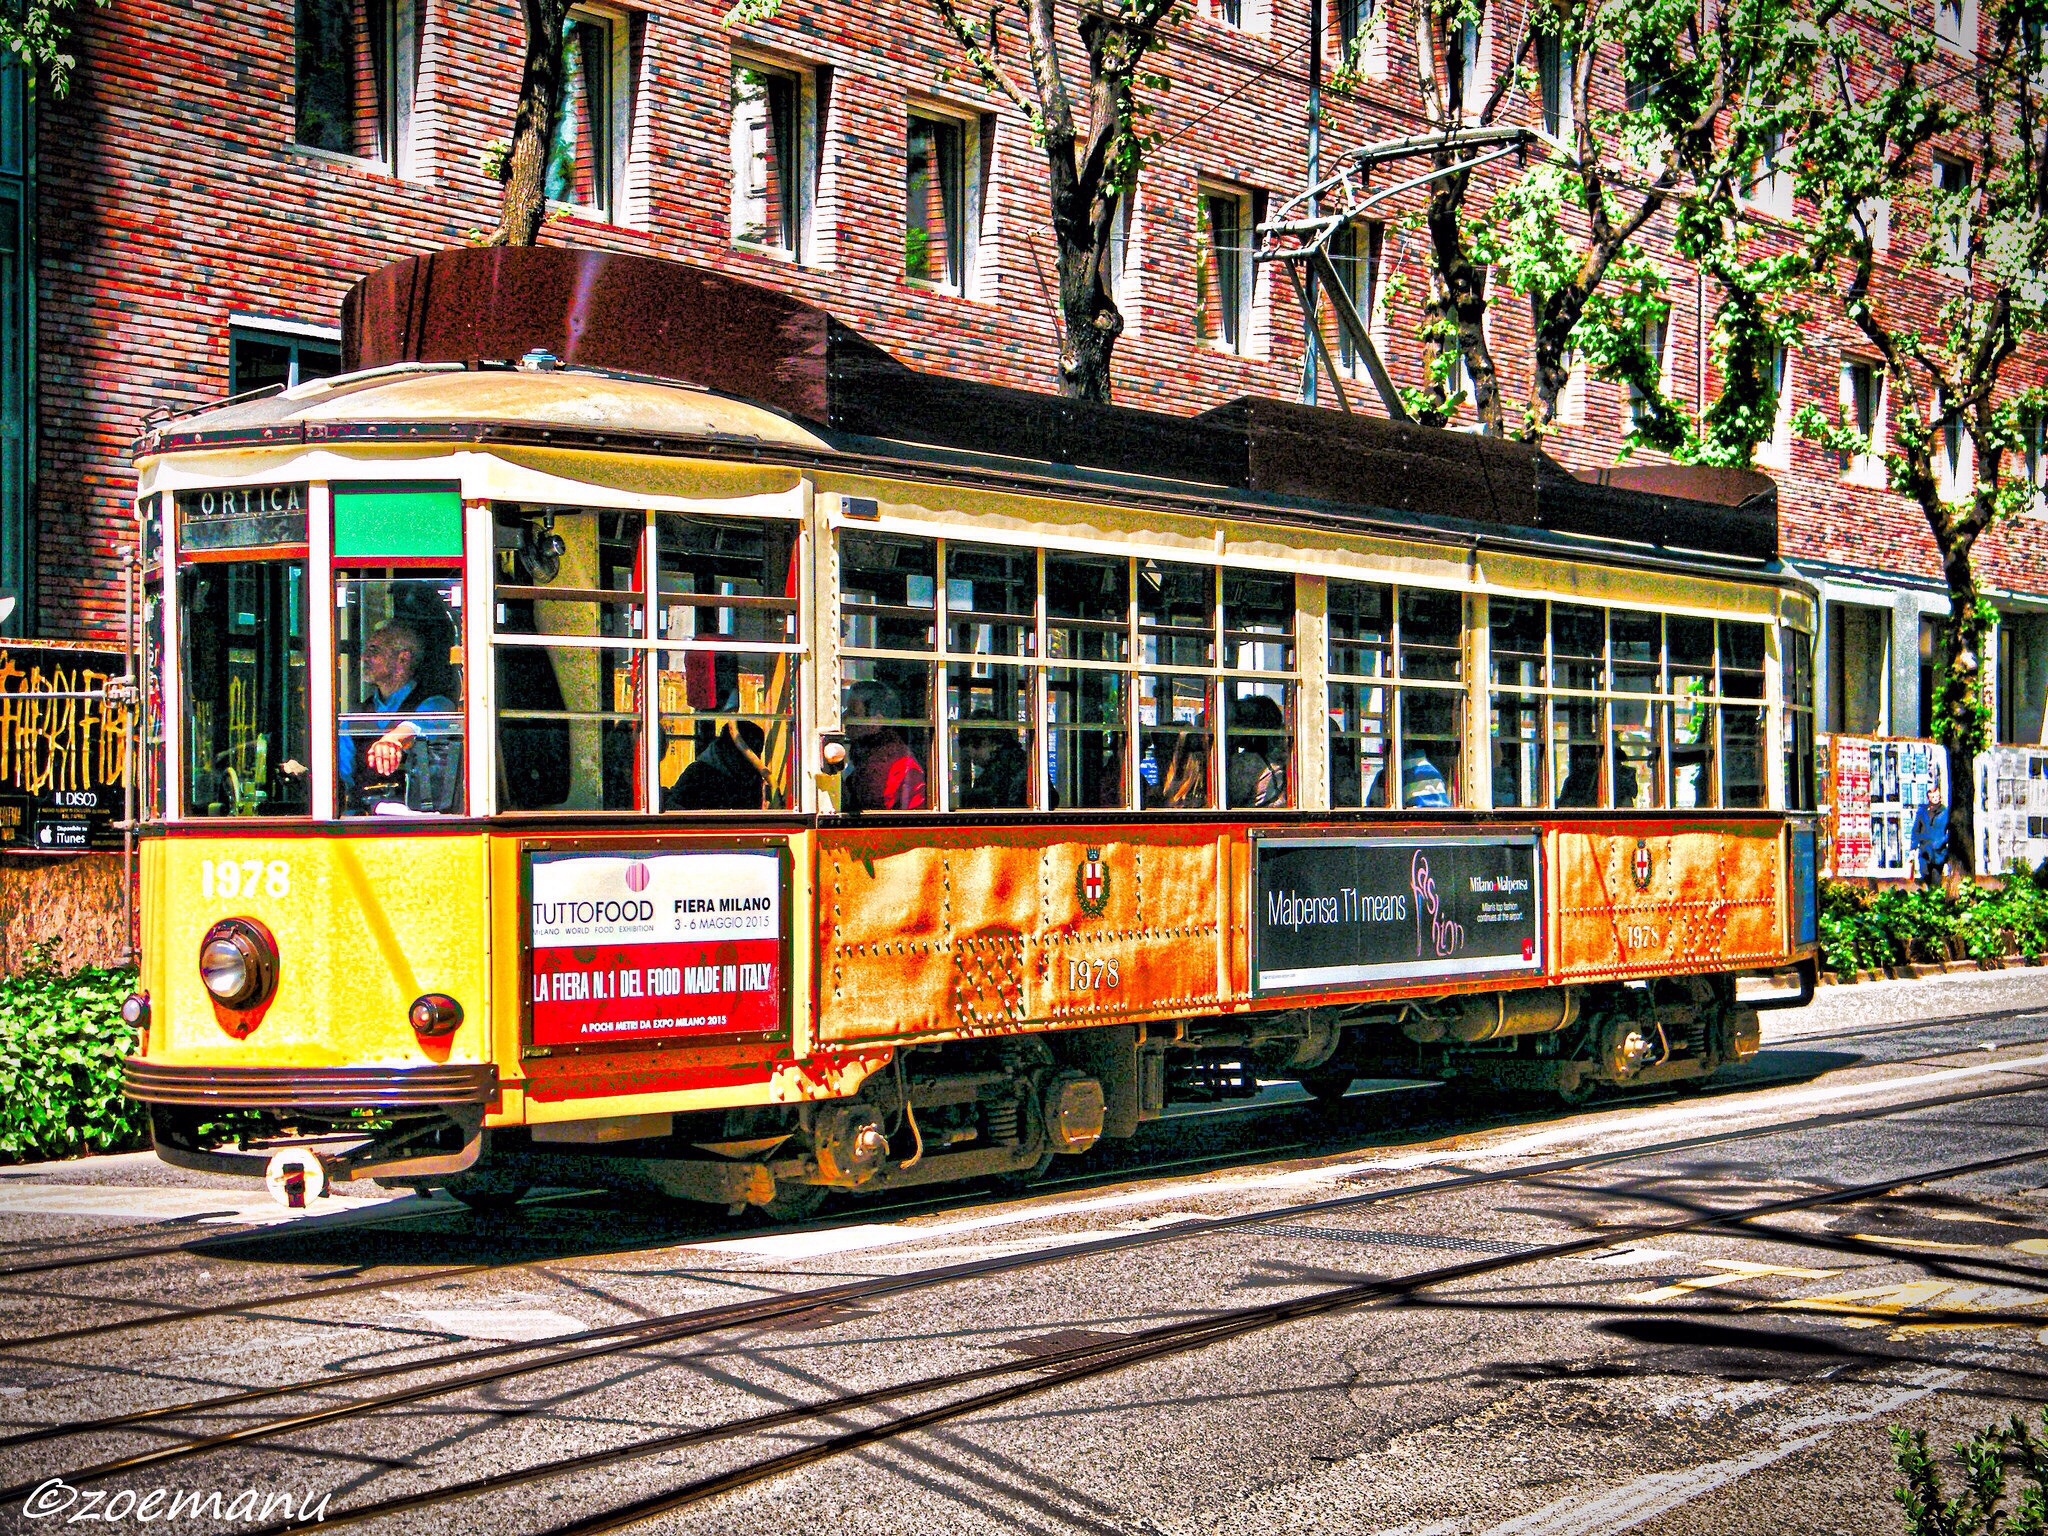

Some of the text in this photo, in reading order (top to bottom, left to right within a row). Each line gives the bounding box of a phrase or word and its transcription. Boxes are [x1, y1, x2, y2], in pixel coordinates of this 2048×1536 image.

[201, 487, 299, 516] ORTICA
[55, 791, 64, 805] IL
[57, 832, 86, 843] iTunes
[201, 859, 290, 898] 1978
[1470, 876, 1528, 894] Milano Malpensa
[533, 900, 654, 925] TUTTOFOOD
[674, 897, 771, 913] FIERA MILANO
[1269, 890, 1338, 932] Malpensa
[1341, 888, 1358, 922] T1
[1362, 892, 1406, 921] means
[619, 925, 654, 933] EXHIBITION
[674, 919, 680, 930] 3
[690, 918, 697, 930] 6
[700, 917, 742, 929] MAGGIO
[746, 916, 770, 928] 2015
[1627, 925, 1659, 948] 1978
[534, 963, 771, 1002] LA FIERA N.1 DEL FOOD MADE IN ITALY
[1069, 958, 1120, 991] 1978
[589, 1022, 613, 1032] POCHI
[616, 1021, 638, 1031] METRI
[640, 1020, 651, 1030] DA
[653, 1018, 673, 1028] EXPO
[676, 1017, 705, 1028] MILANO
[708, 1016, 726, 1025] 2015
